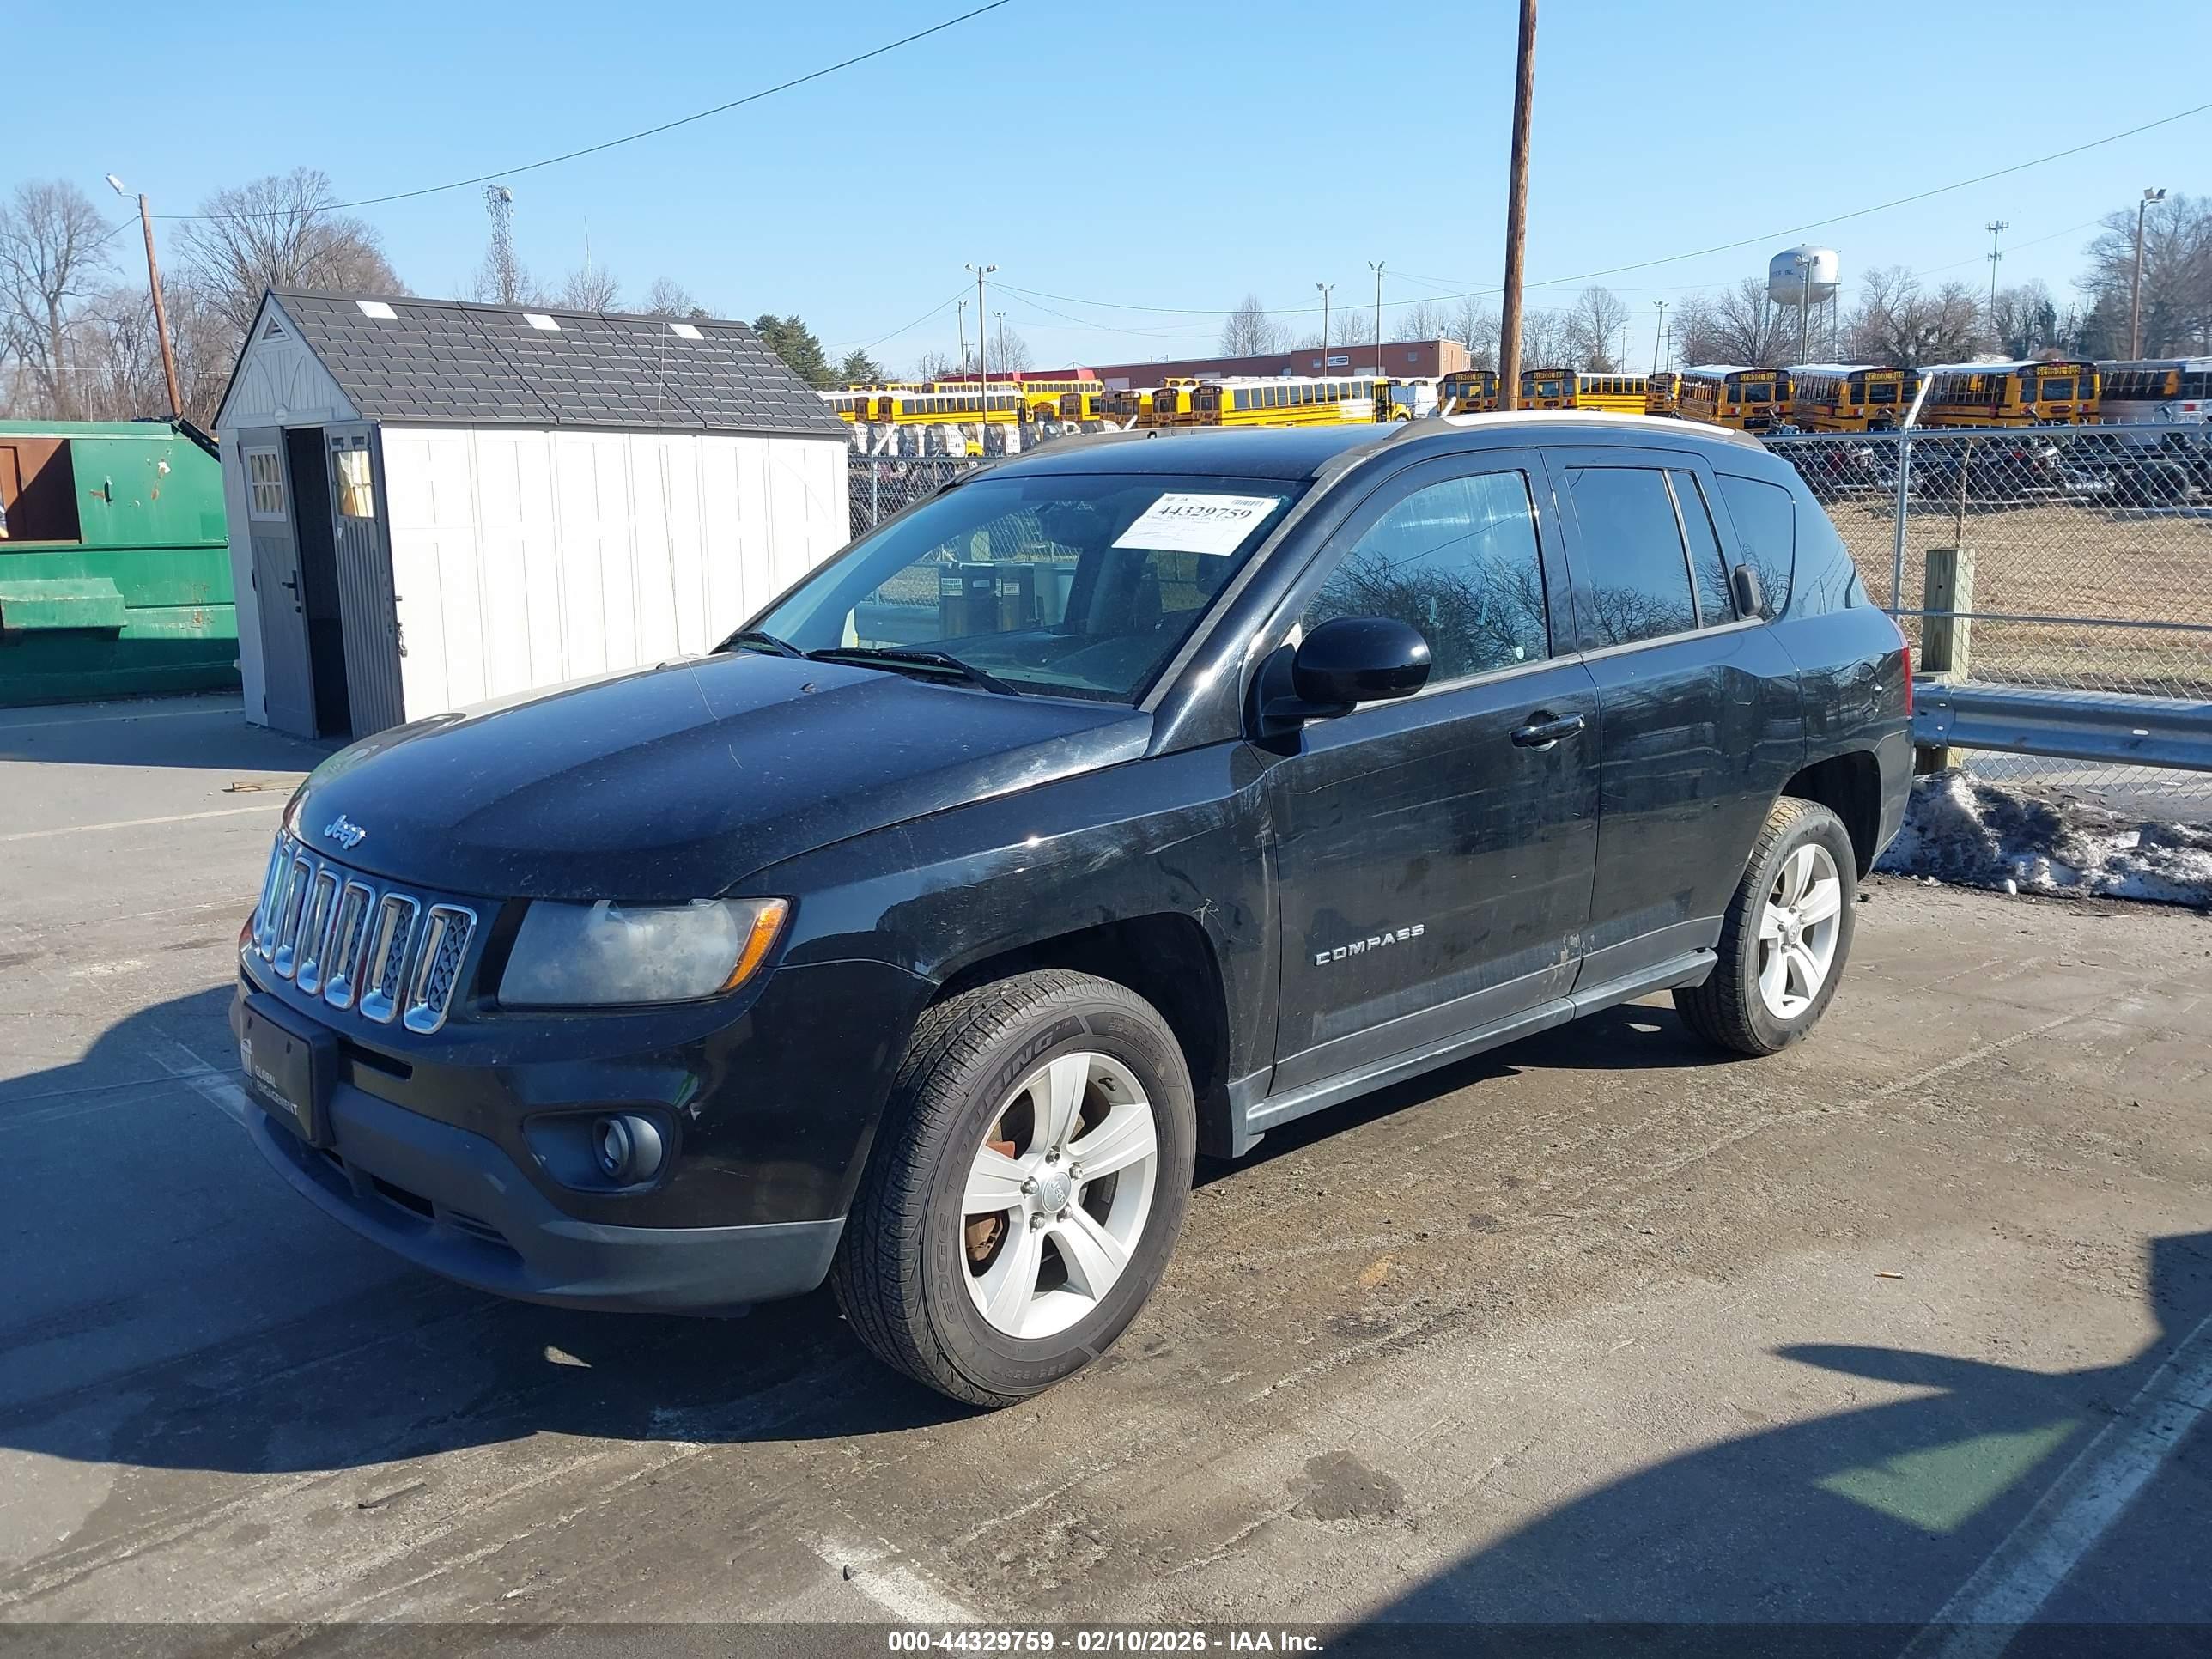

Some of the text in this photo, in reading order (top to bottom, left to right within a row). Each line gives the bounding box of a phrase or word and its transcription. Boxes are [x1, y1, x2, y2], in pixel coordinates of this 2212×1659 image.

[1740, 372, 1777, 382] SCHOOL BUS
[1865, 370, 1905, 381] SCHOOL BUS
[2036, 364, 2081, 376] SCHOOL BUS
[1158, 505, 1253, 520] 44329759
[324, 814, 367, 850] Jeep
[1315, 924, 1425, 965] COMPASS
[945, 1032, 1054, 1194] TOURING
[1050, 1180, 1066, 1205] Jeep
